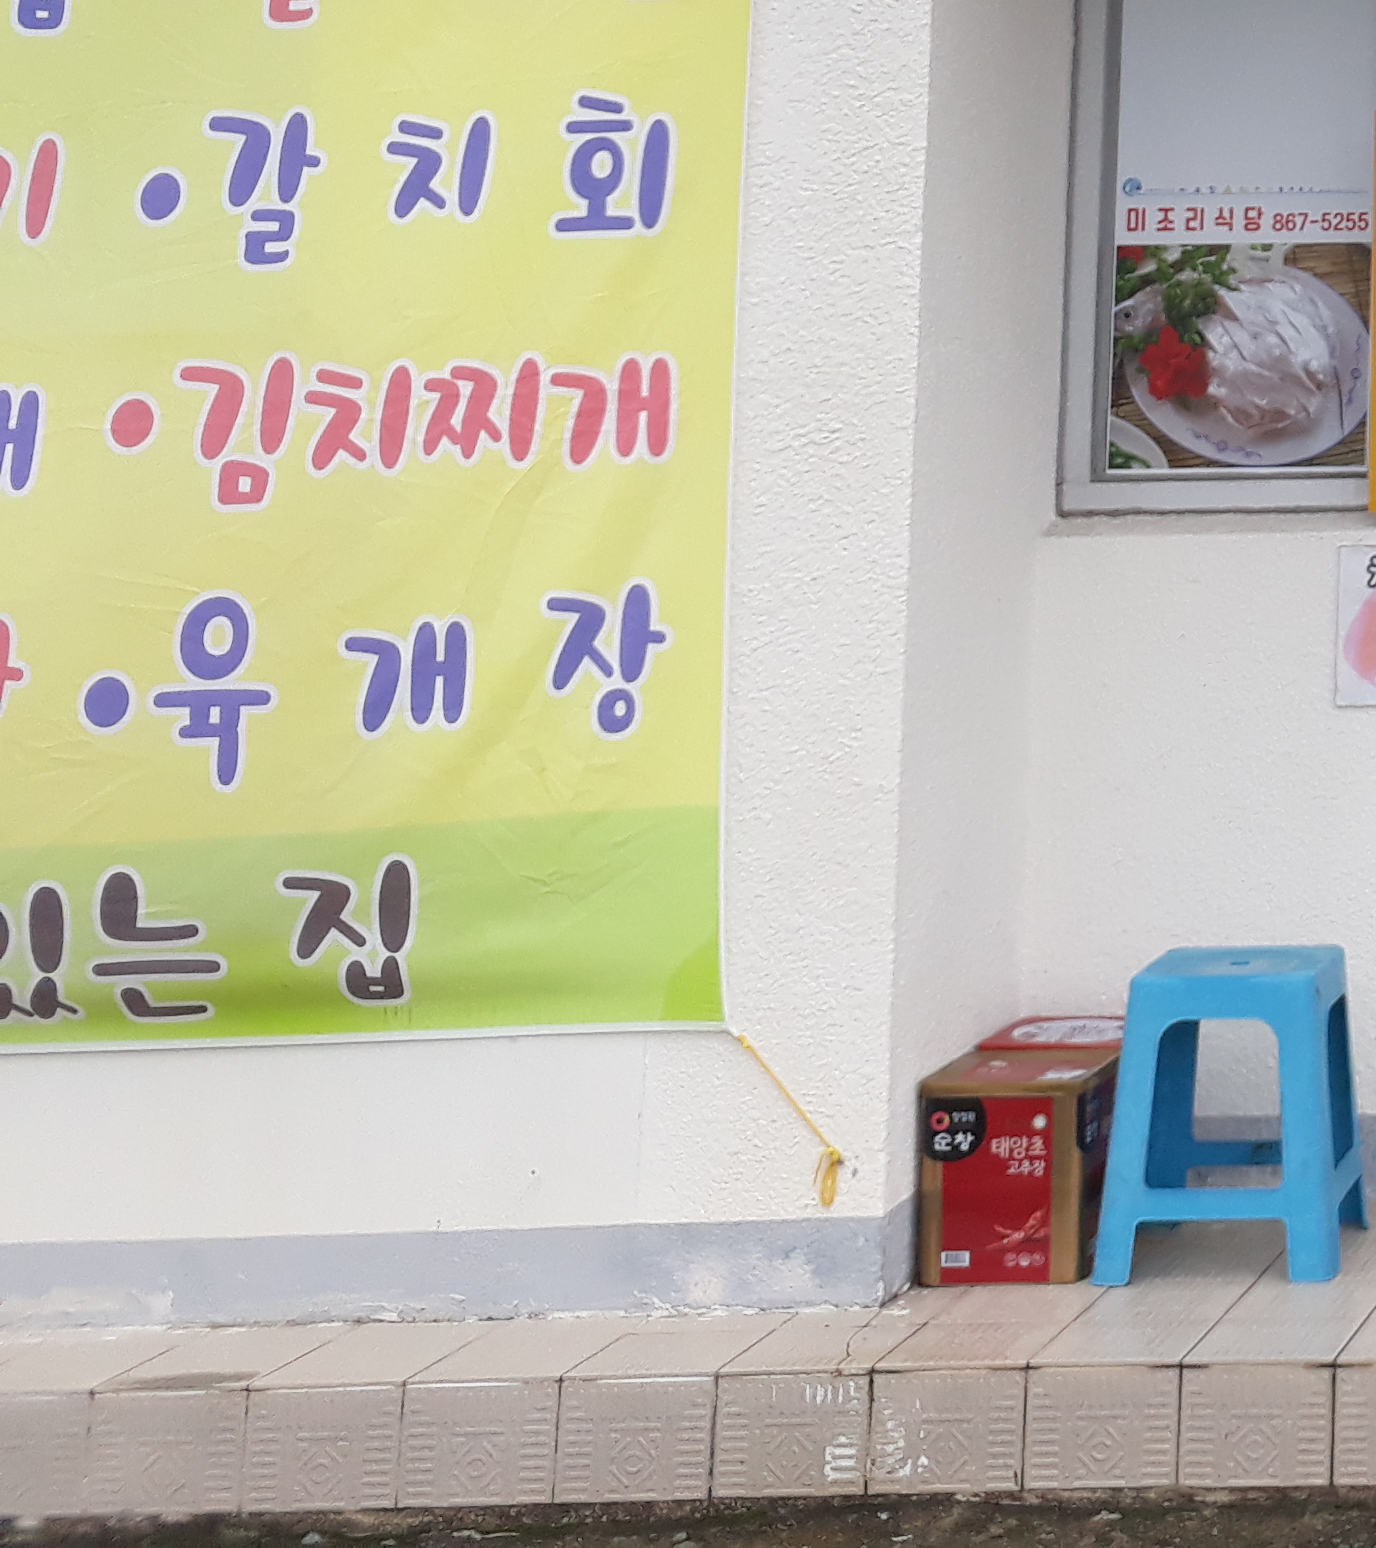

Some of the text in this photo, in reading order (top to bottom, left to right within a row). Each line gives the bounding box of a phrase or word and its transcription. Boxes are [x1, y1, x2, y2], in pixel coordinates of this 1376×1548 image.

[207, 93, 671, 265] 갈치회
[1126, 206, 1370, 232] 미조리식당 867-5255
[179, 357, 673, 506] 김치찌개
[153, 584, 667, 786] 육개장
[282, 860, 411, 1002] 집
[933, 1130, 976, 1152] 순창
[990, 1134, 1048, 1160] 태양초
